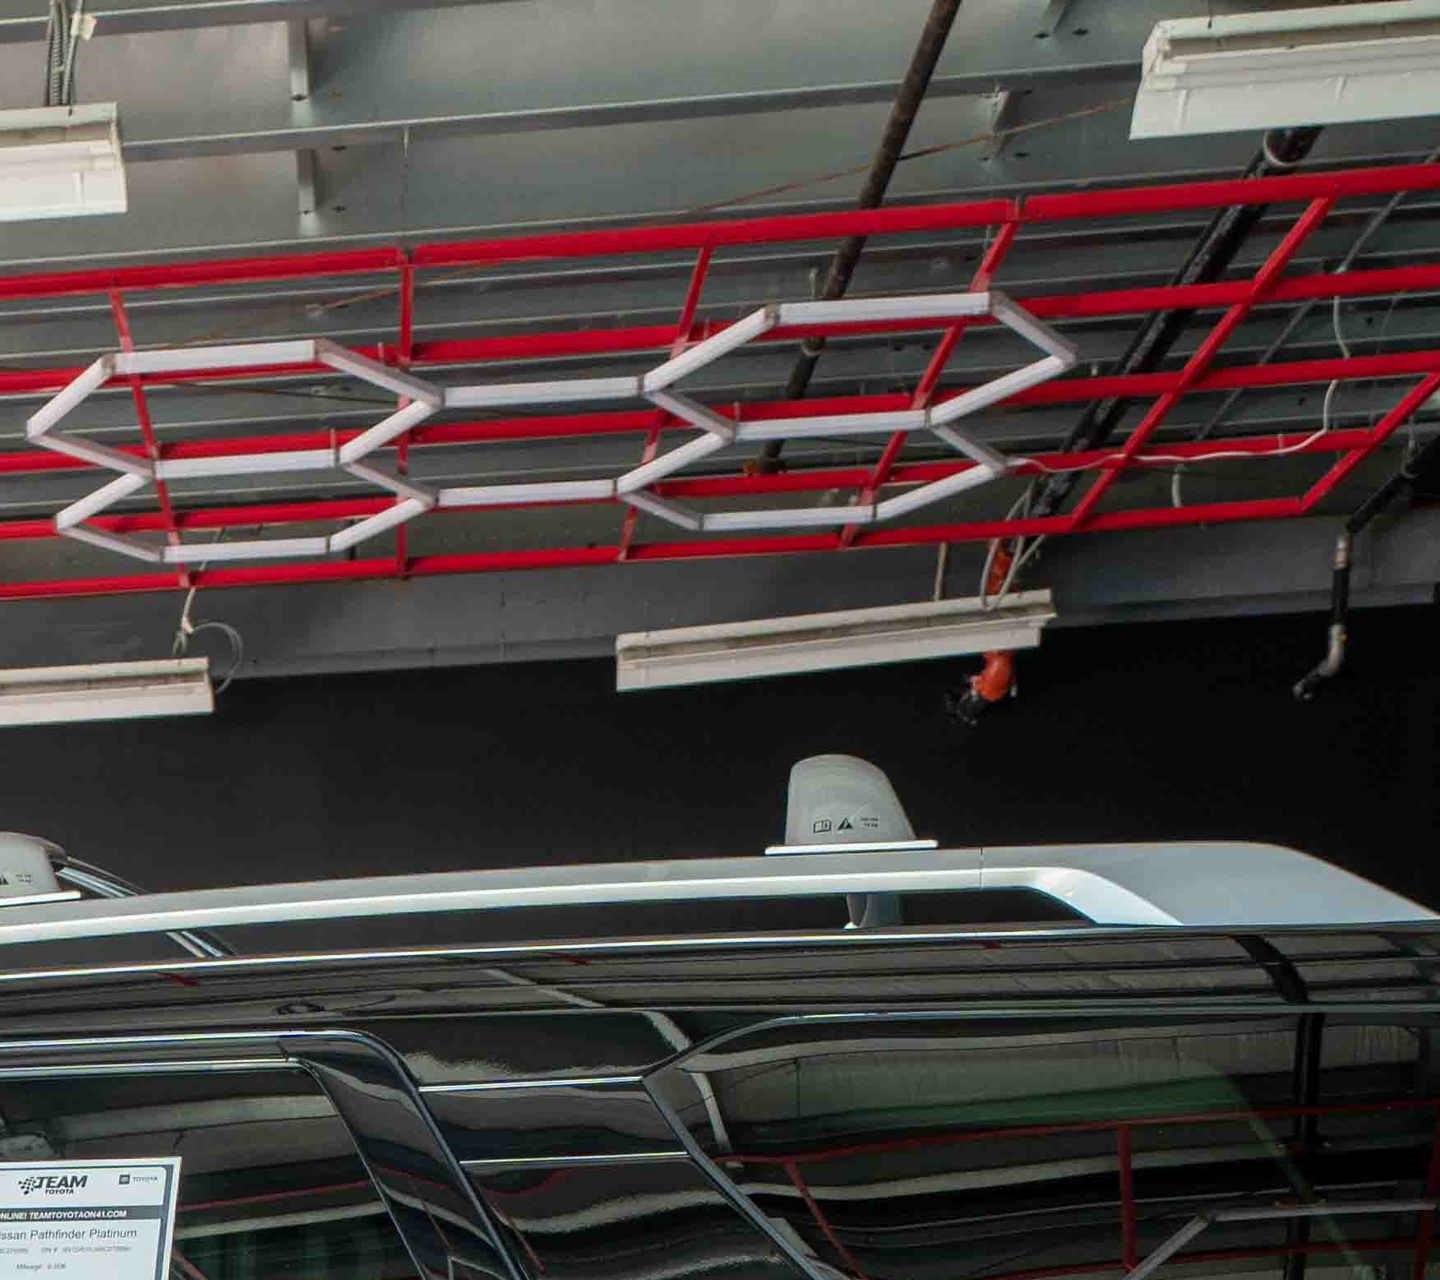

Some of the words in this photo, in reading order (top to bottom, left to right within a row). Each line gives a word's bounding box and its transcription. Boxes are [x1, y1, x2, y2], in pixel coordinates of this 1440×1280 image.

[34, 1175, 88, 1189] TEAM
[30, 1228, 86, 1240] Pathfinder
[88, 1228, 137, 1239] Platinum
